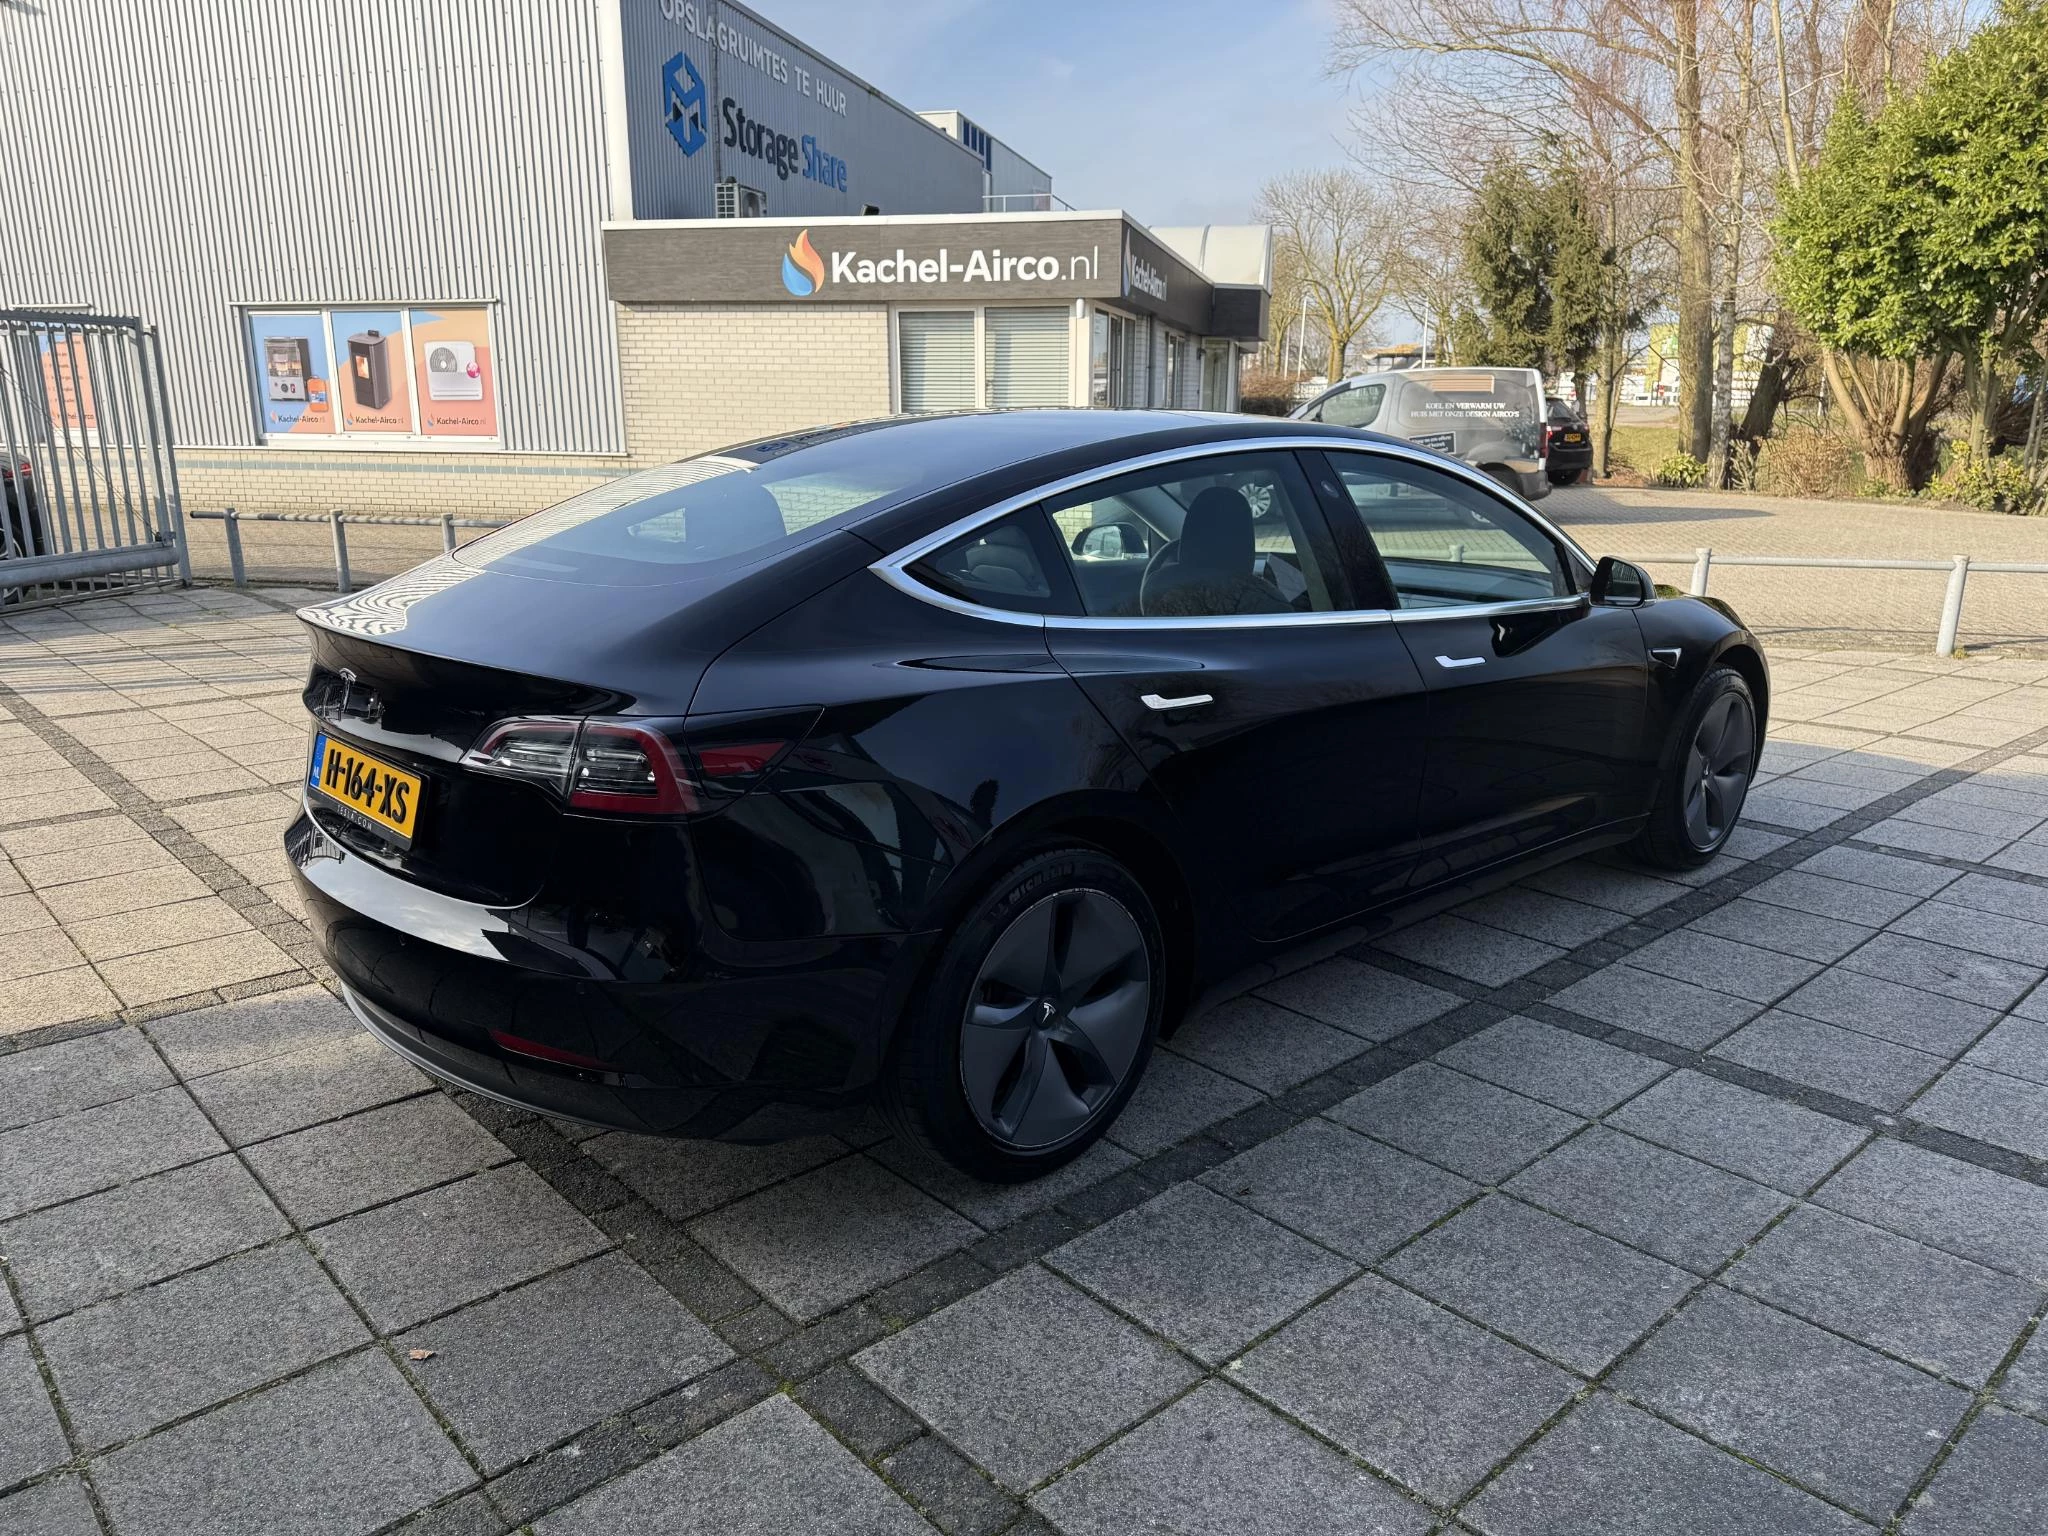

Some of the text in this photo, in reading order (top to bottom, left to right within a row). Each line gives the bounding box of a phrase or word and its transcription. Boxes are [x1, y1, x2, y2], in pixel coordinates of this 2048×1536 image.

[660, 0, 847, 117] OPSLAGRUIMTES TE HUUR
[832, 245, 1099, 284] Kachel-Airco.nl
[1410, 410, 1520, 418] HUIS MET ONZE DESIGN AIRCO'S
[1425, 402, 1506, 410] KOEL EN VERWARM UW
[312, 766, 320, 779] NL
[325, 748, 410, 825] H-164-XS
[337, 804, 372, 831] TESLA.COM
[1008, 861, 1075, 904] MICHELIN
